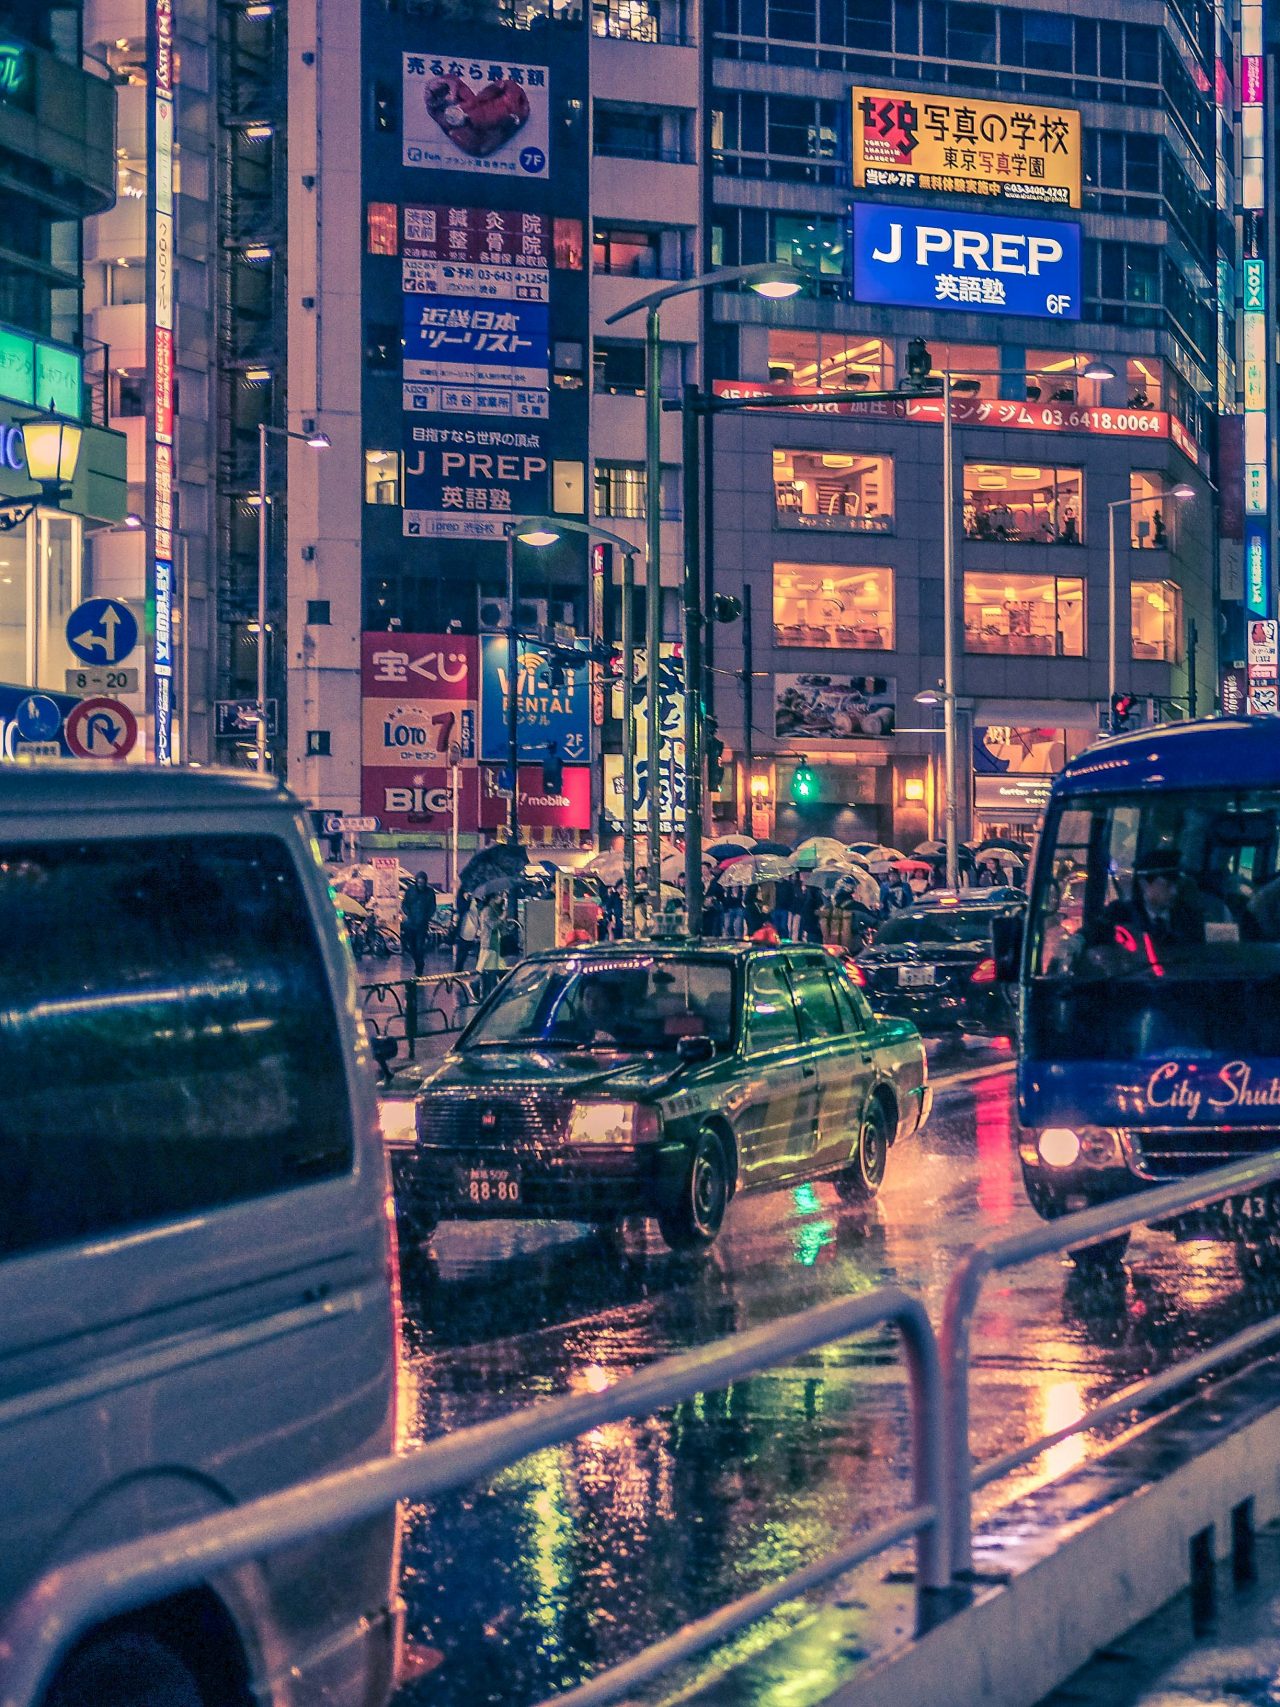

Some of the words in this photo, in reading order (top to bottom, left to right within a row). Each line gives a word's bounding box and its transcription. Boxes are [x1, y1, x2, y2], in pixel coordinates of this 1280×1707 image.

[407, 57, 545, 87] 売るなら最高額
[924, 103, 1069, 155] 写真の学校
[523, 153, 542, 166] 7F
[943, 146, 1045, 179] 東京写真学園
[448, 207, 542, 234] 鍼灸院
[872, 223, 904, 264] J
[915, 225, 1064, 277] PREP
[935, 272, 1006, 305] 英語塾
[1248, 264, 1261, 306] NOVA
[1046, 294, 1072, 315] 6F
[420, 307, 520, 332] 近畿日本
[420, 329, 533, 353] ツーリスト
[1042, 409, 1160, 433] 03.6418.0064
[412, 427, 540, 448] 目指すなら世界の頂点
[406, 451, 426, 475] J
[441, 452, 547, 481] PREP
[441, 486, 511, 511] 英語塾
[156, 565, 170, 661] WEMBLEY
[372, 650, 468, 683] 宝くじ
[566, 733, 584, 747] 2F
[384, 787, 455, 813] BIG
[1146, 1061, 1201, 1120] City
[469, 1181, 519, 1201] 88-80
